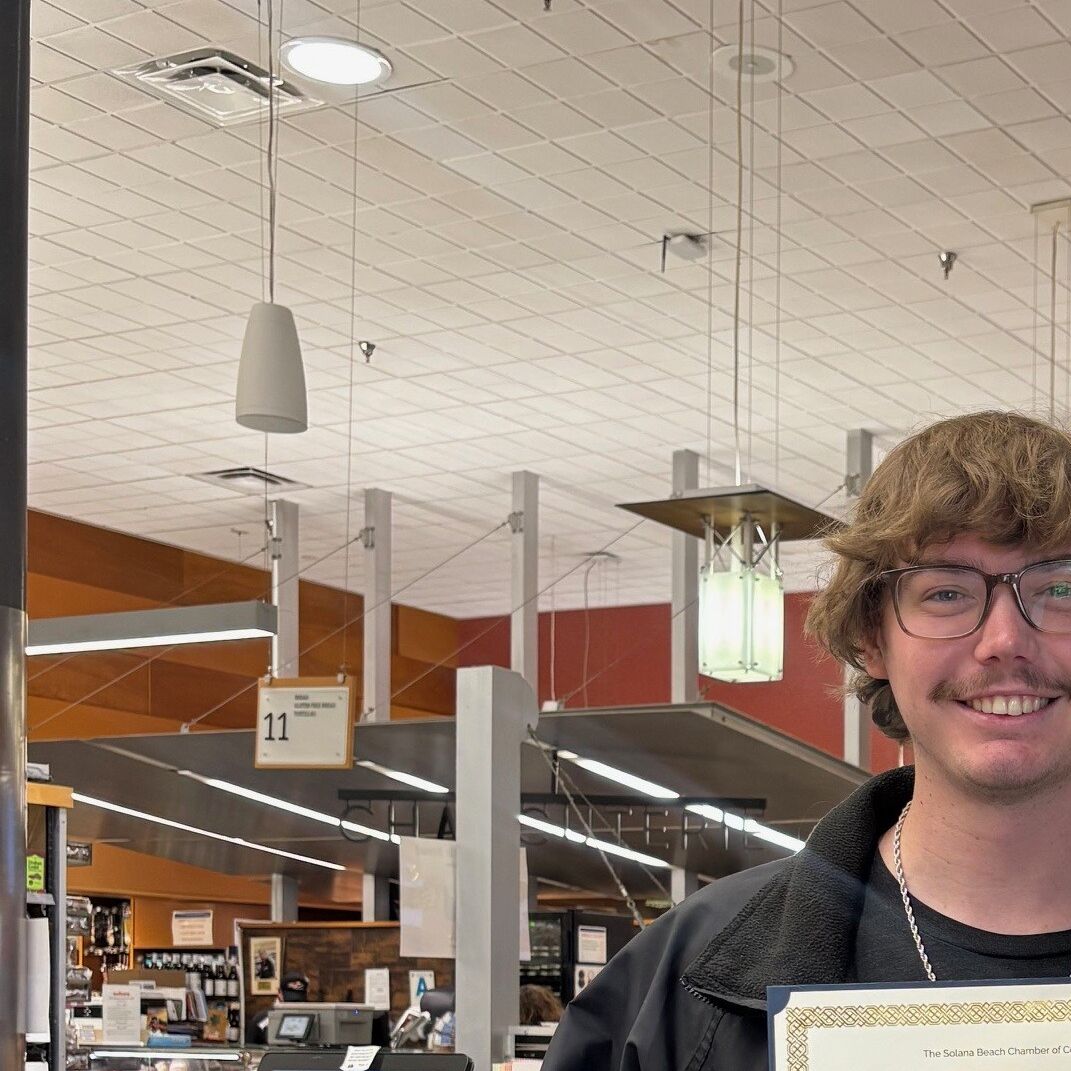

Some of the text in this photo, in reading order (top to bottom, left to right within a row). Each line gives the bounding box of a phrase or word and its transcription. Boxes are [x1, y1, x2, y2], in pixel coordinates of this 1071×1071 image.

[264, 712, 289, 741] 11
[923, 1050, 941, 1058] The
[943, 1049, 974, 1057] Solana
[976, 1048, 1006, 1056] Beach
[1007, 1047, 1049, 1056] Chamber
[1052, 1046, 1062, 1054] of
